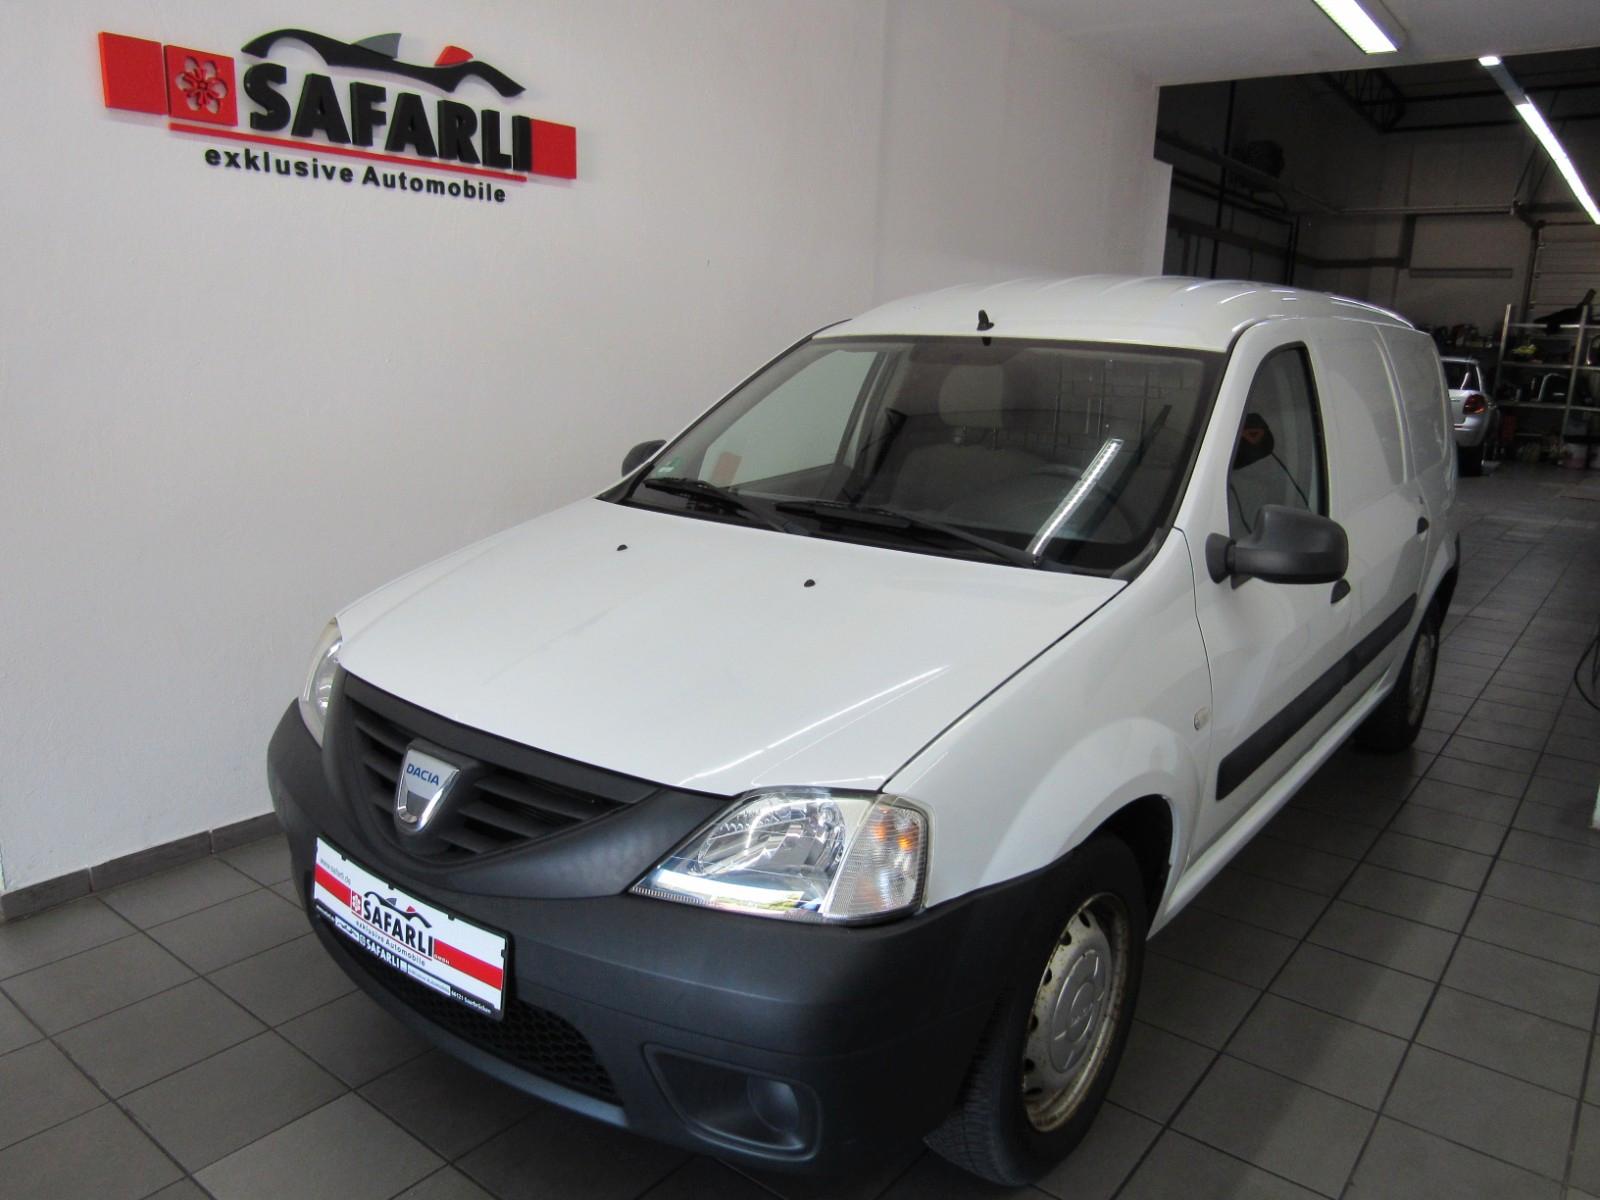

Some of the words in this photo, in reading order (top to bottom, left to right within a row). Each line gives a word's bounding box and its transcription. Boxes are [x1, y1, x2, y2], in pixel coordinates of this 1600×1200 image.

[243, 62, 533, 173] SAFARLI
[204, 146, 355, 185] exklusive
[362, 165, 506, 203] Automobile
[406, 763, 440, 786] DACIA
[363, 899, 433, 957] SAFARLI
[365, 938, 400, 969] SAFARLI
[385, 938, 426, 967] Automobile
